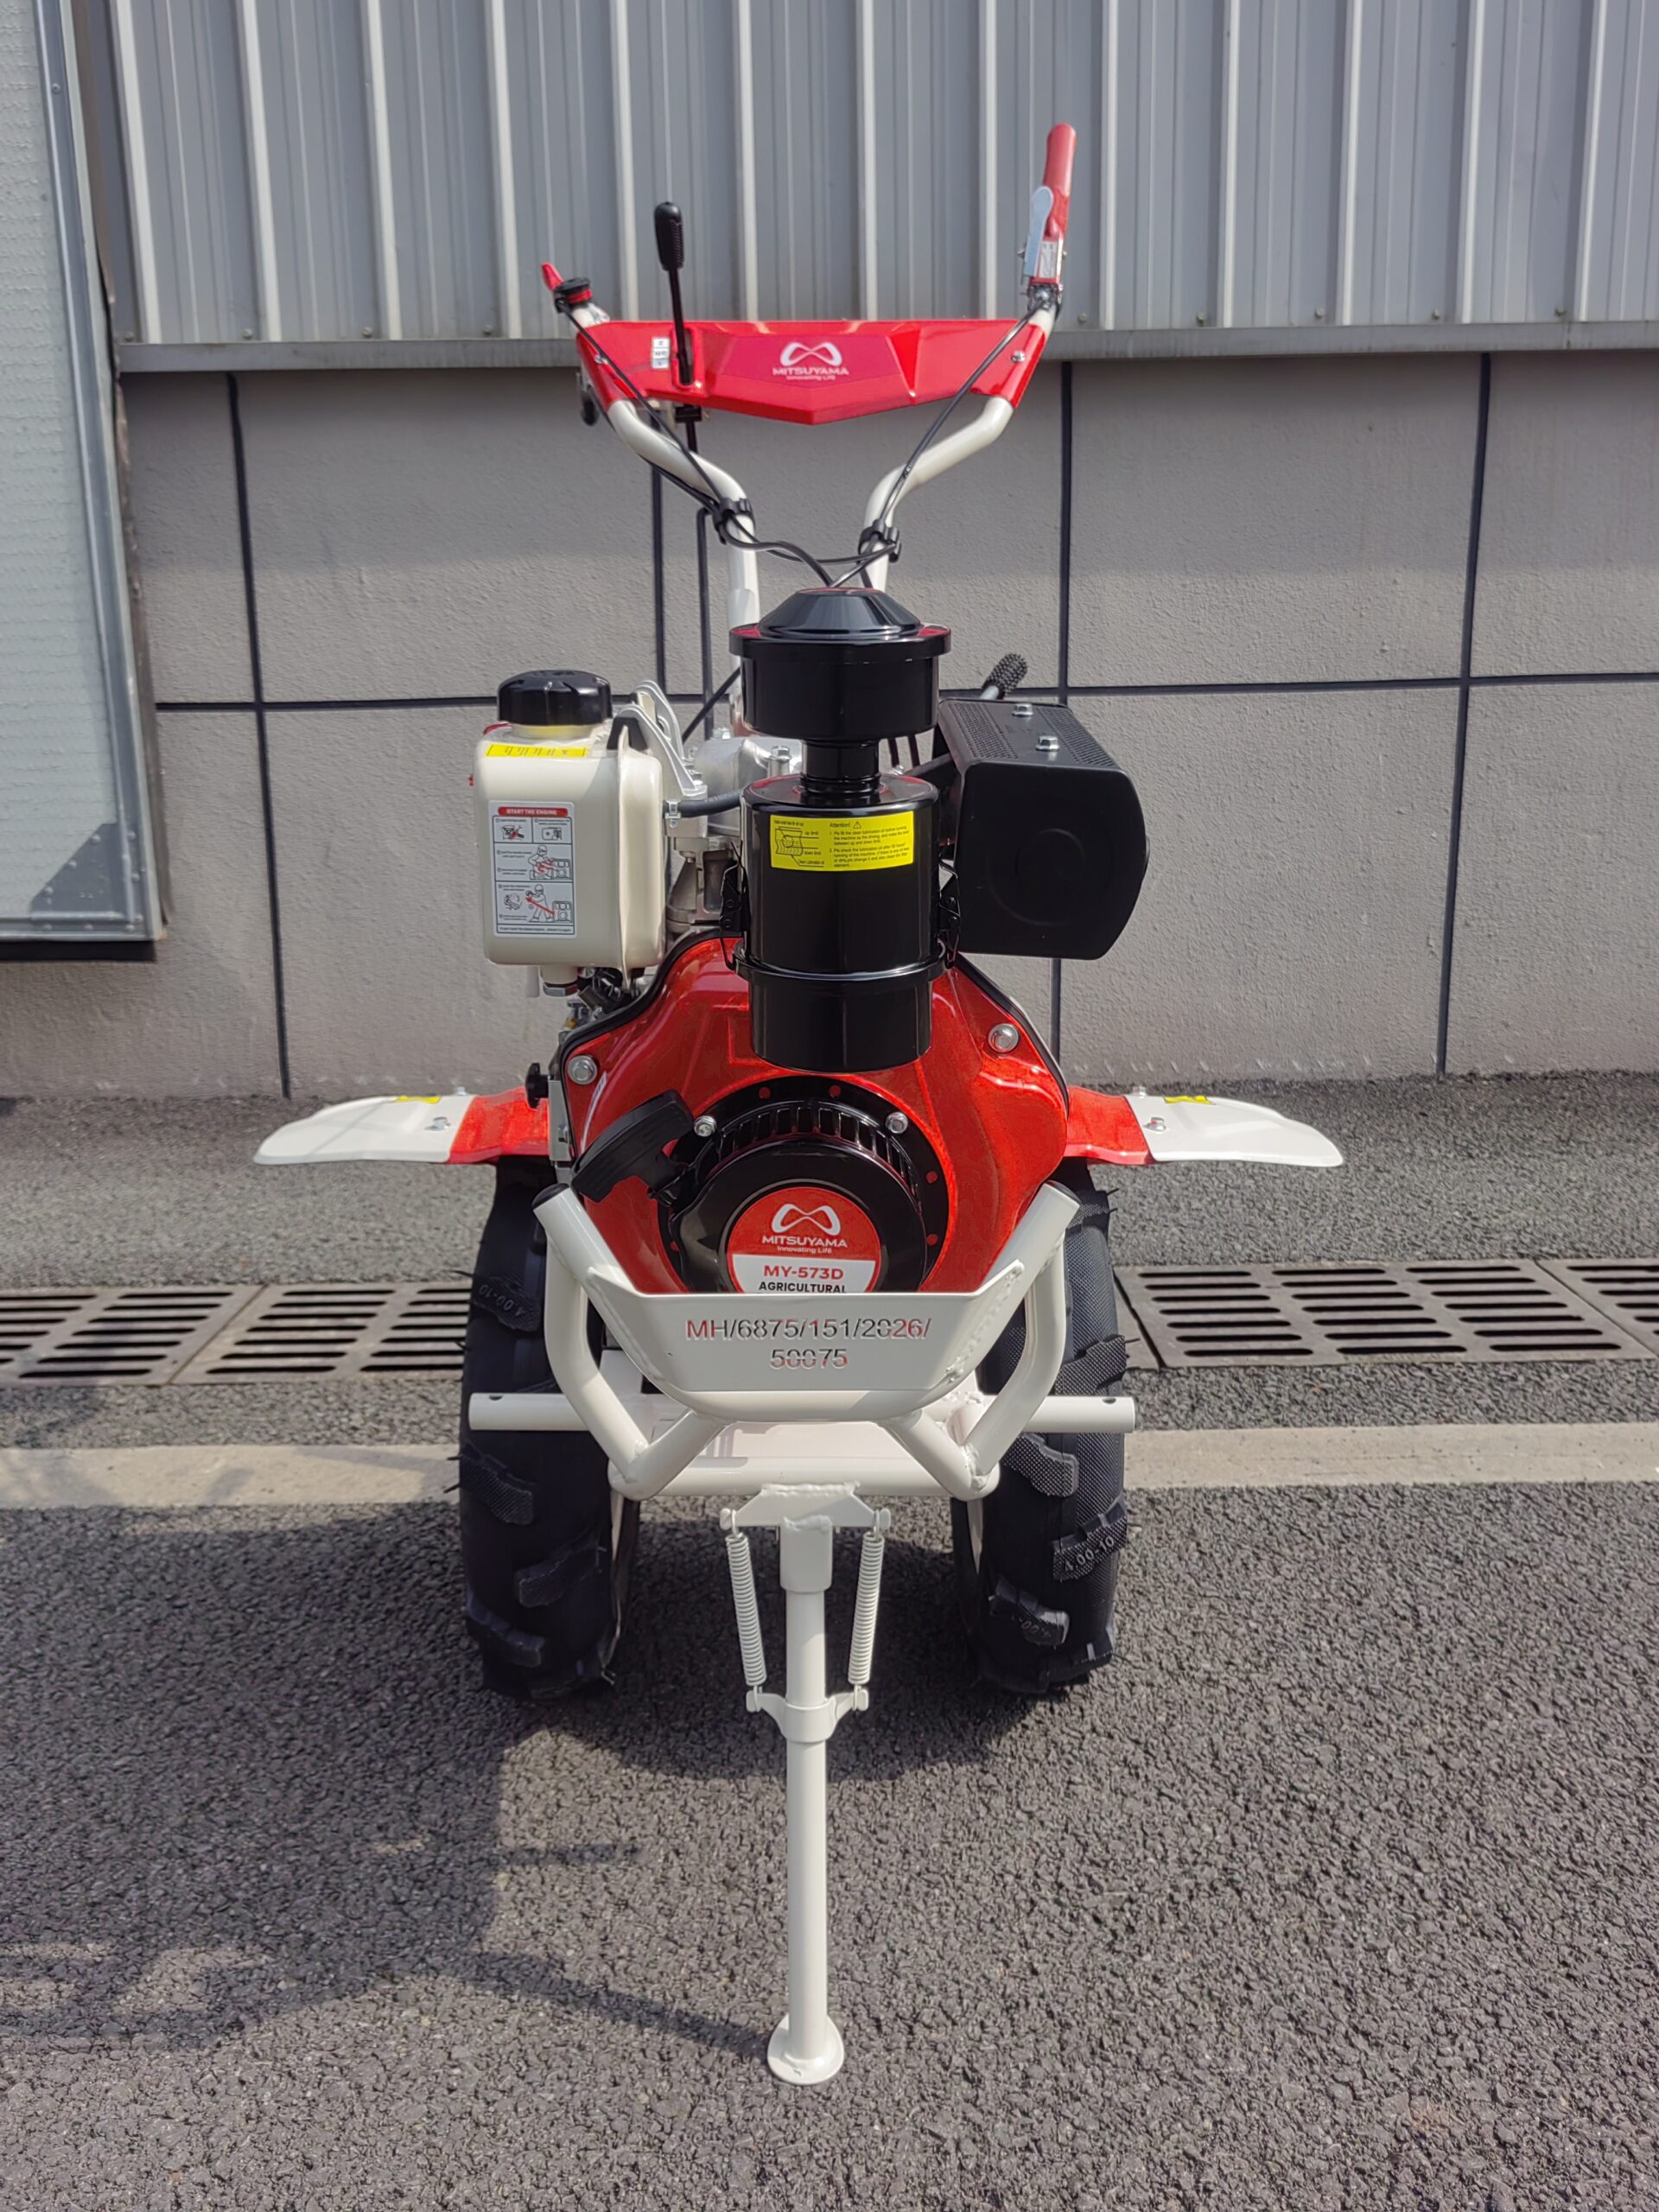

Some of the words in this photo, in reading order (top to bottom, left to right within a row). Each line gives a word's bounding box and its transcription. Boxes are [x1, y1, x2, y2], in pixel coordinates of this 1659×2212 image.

[772, 367, 849, 376] MITSUYAMA
[762, 1236, 848, 1248] MITSUYAMA
[777, 1245, 817, 1254] Innovating
[764, 1264, 844, 1281] MY-573D
[758, 1281, 846, 1294] AGRICULTURAL
[770, 1349, 848, 1369] 50075
